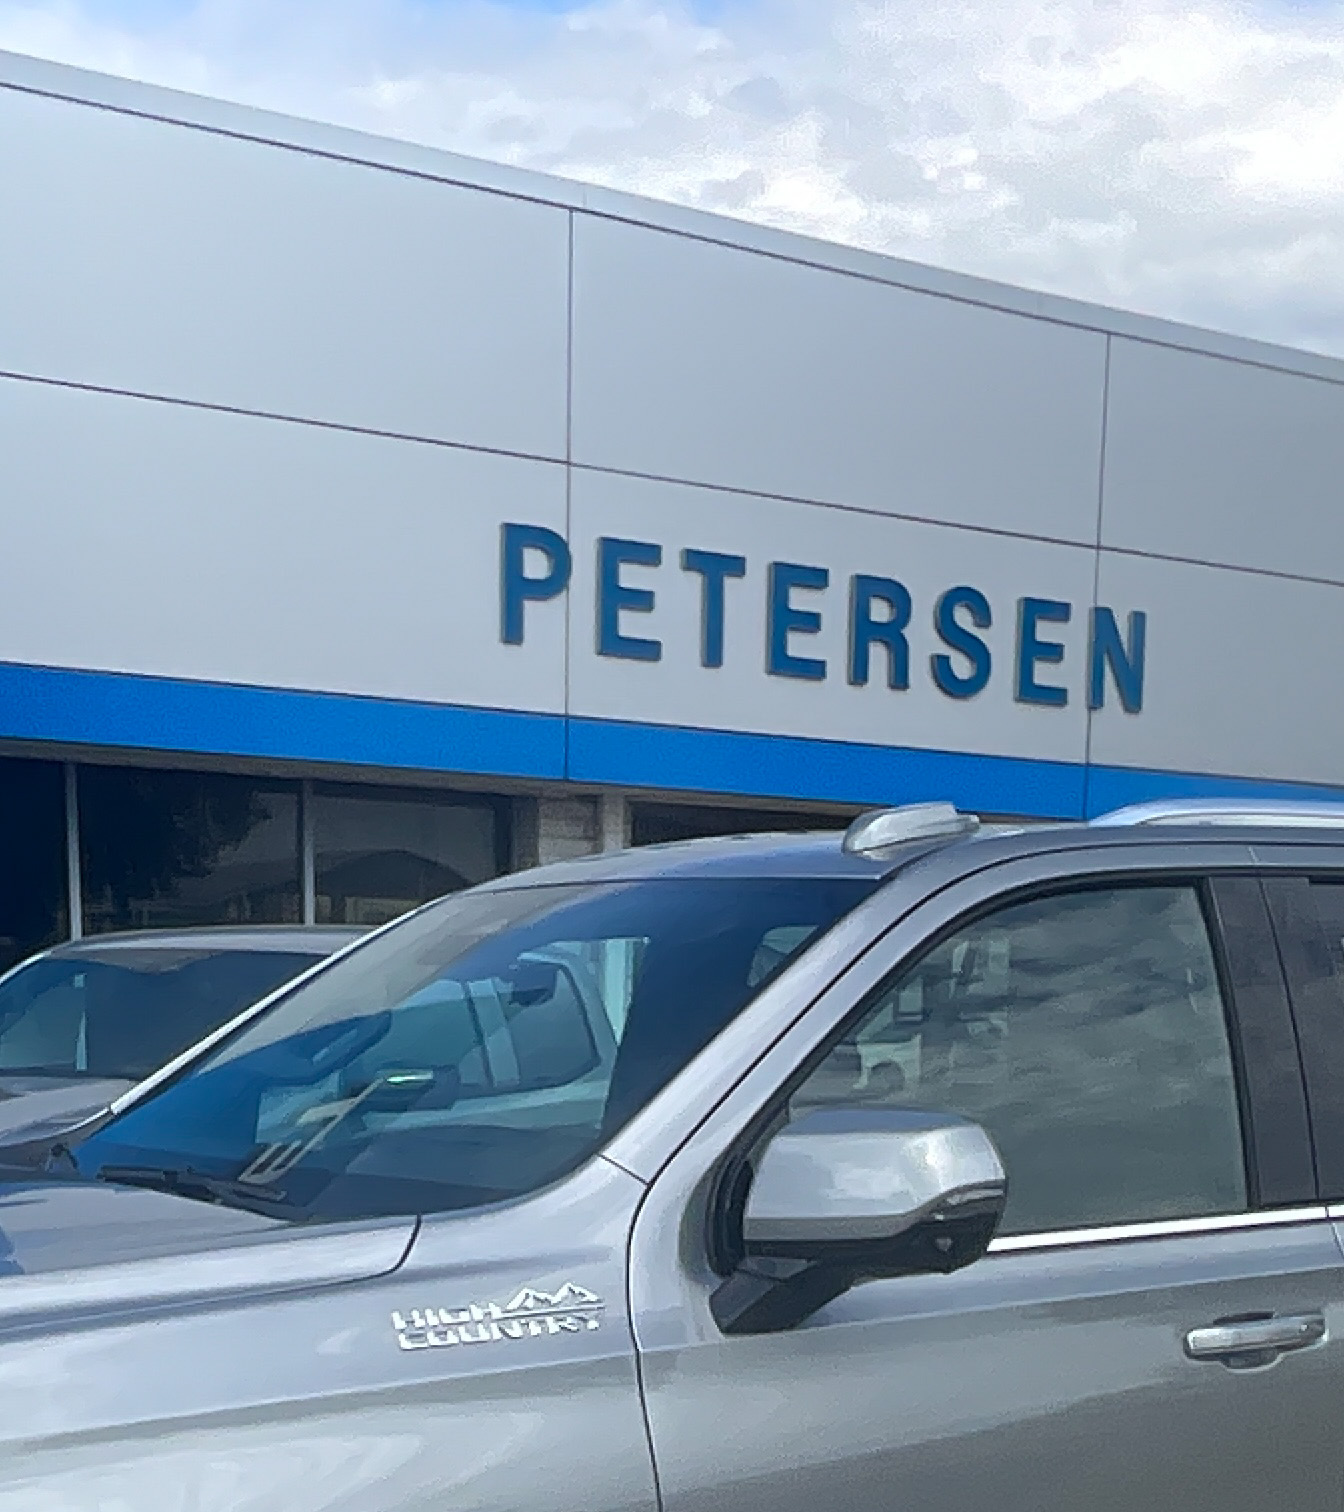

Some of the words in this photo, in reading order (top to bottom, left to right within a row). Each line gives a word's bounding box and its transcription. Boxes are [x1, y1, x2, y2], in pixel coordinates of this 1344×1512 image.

[499, 520, 1148, 714] PETERSEN
[391, 1301, 507, 1331] HIGH
[398, 1315, 601, 1351] COUNTRY
